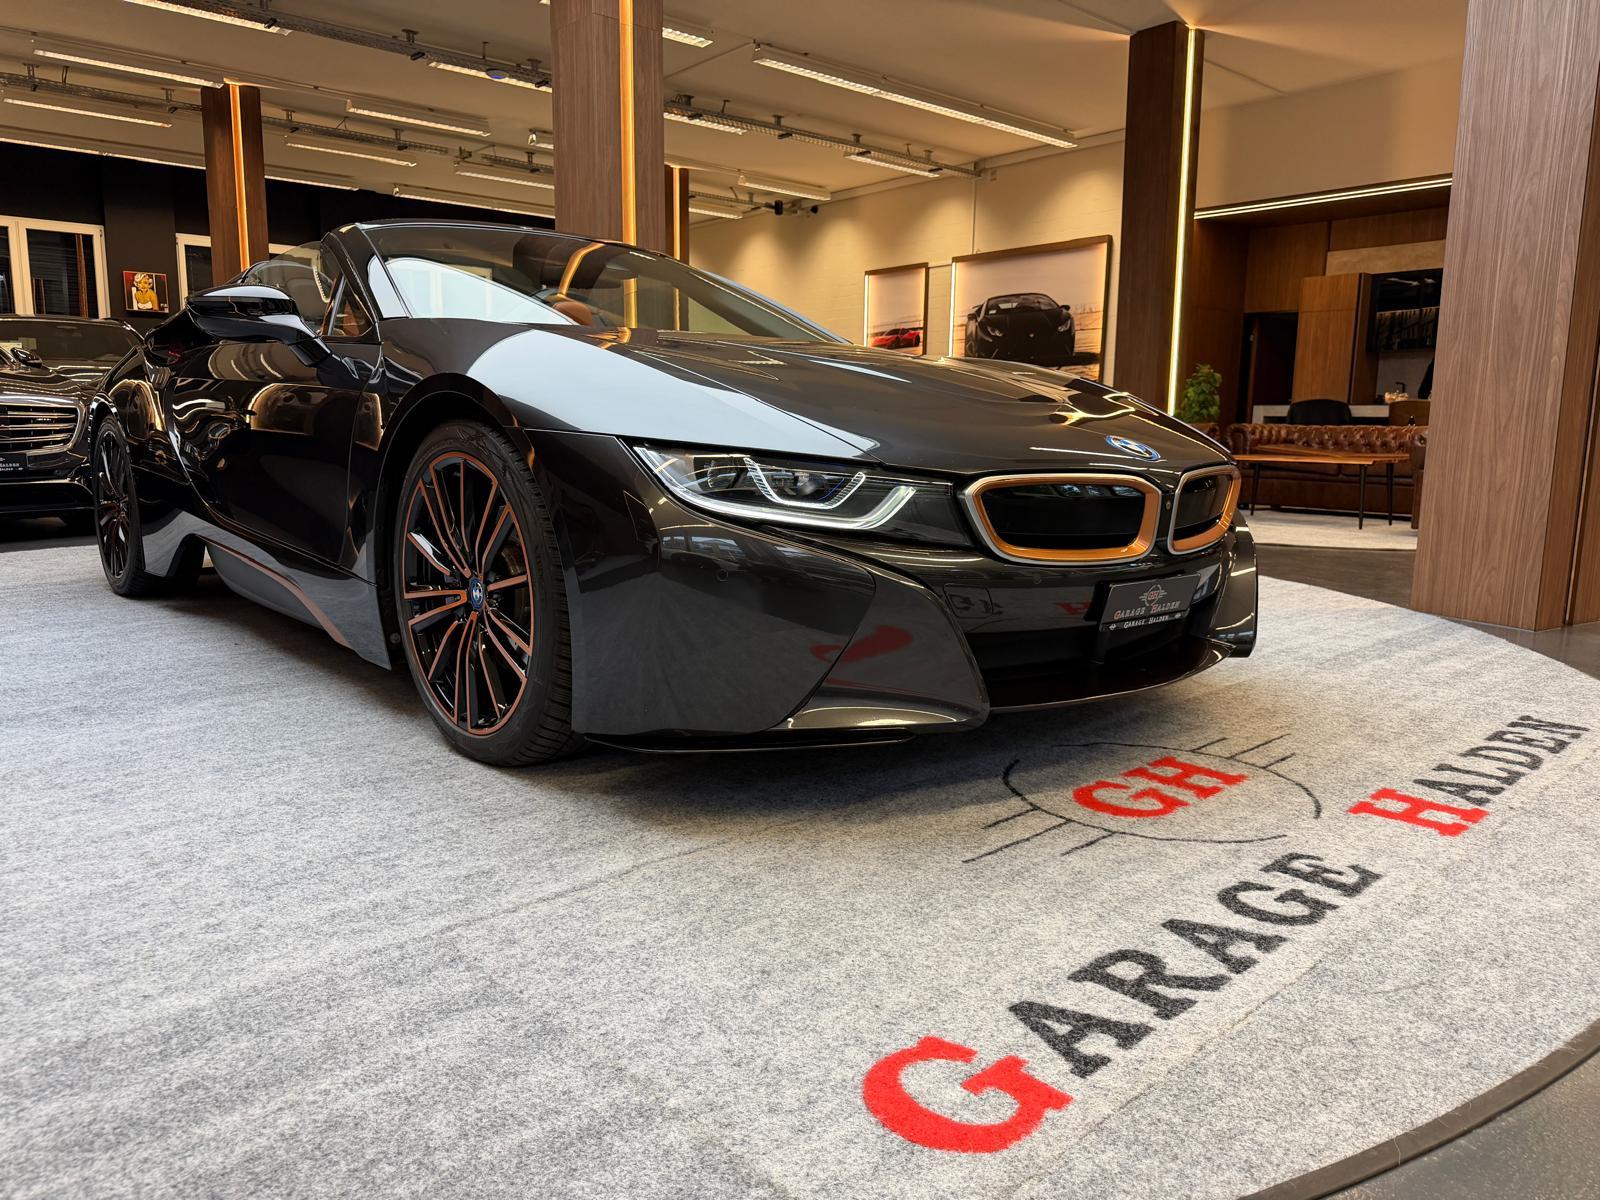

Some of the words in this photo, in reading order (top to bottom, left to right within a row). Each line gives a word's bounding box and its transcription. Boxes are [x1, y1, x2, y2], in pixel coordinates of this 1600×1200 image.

[1113, 607, 1146, 620] GARAGE
[1151, 600, 1180, 614] HALDEN
[1072, 756, 1249, 819] GH
[862, 852, 1383, 1154] GARAGE
[1348, 714, 1591, 837] HALDEN
